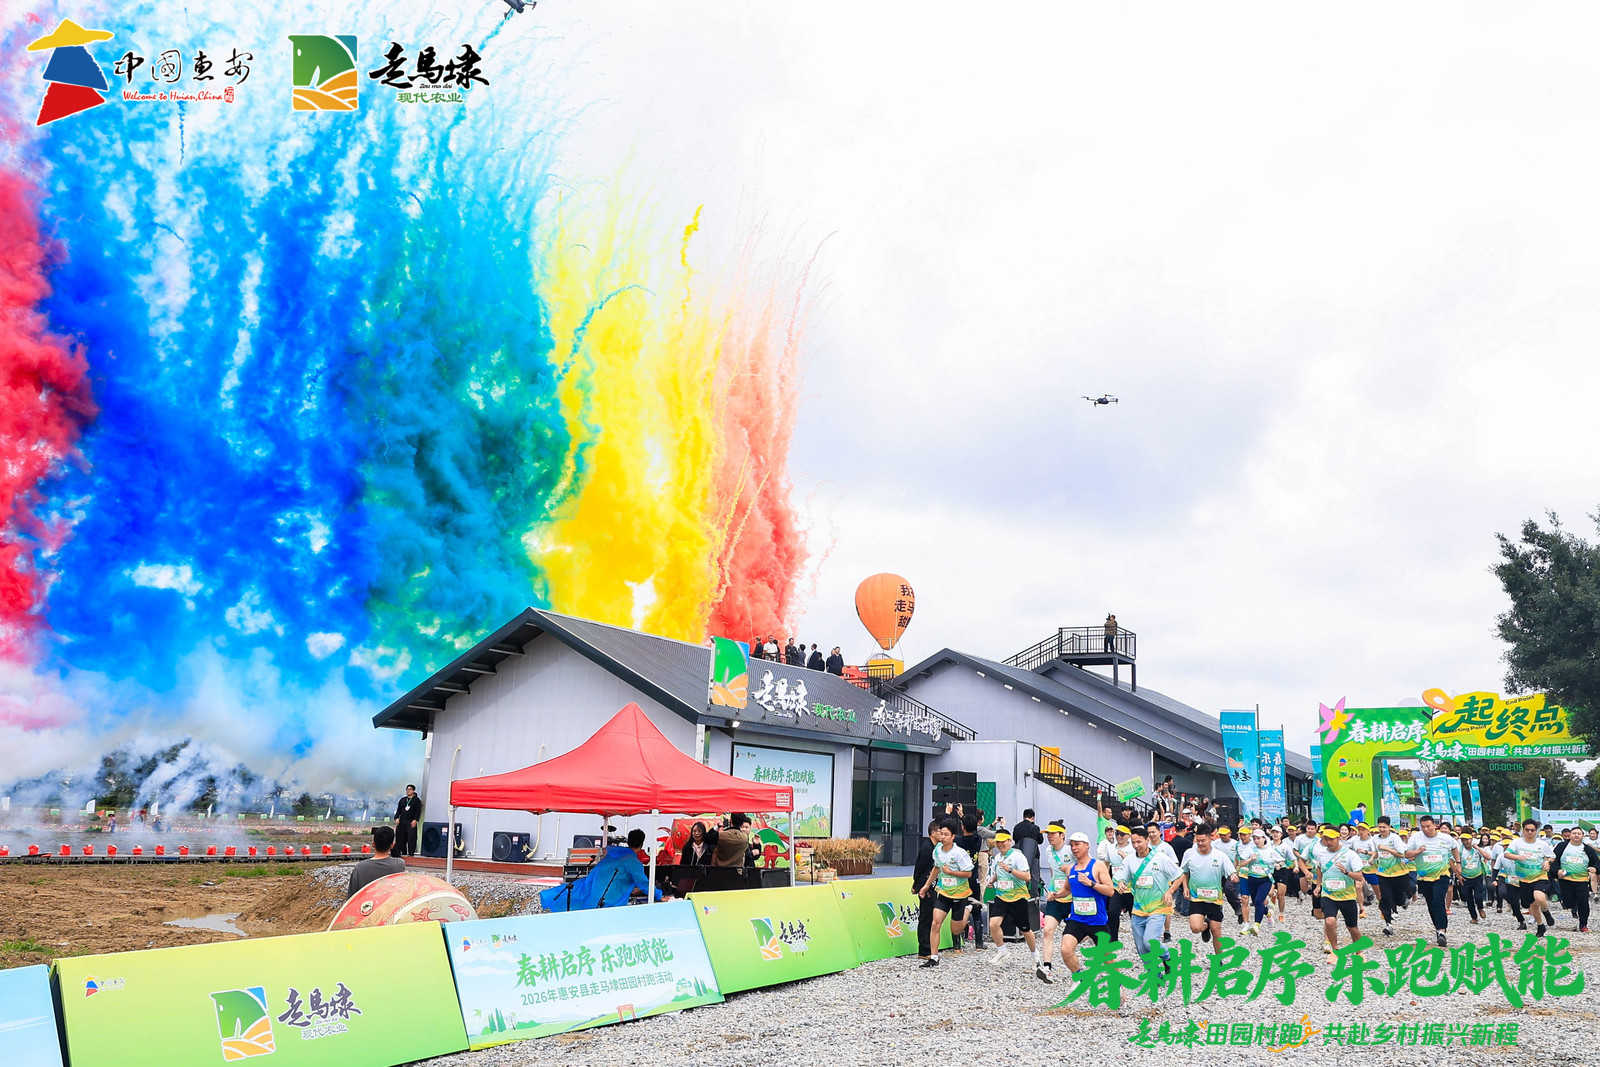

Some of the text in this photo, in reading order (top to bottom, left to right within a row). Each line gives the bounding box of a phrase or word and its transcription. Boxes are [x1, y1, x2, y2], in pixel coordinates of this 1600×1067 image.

[1518, 695, 1535, 704] Point
[1438, 695, 1565, 742] 起终点
[1343, 719, 1427, 743] 春耕启序
[753, 765, 785, 784] 春耕启序
[1489, 763, 1524, 772] 00:00:06
[513, 938, 674, 990] 春耕启序 乐跑赋能
[521, 970, 674, 1006] 2026年惠安县走马埭田园村跑活动
[302, 1024, 347, 1039] 现代农业
